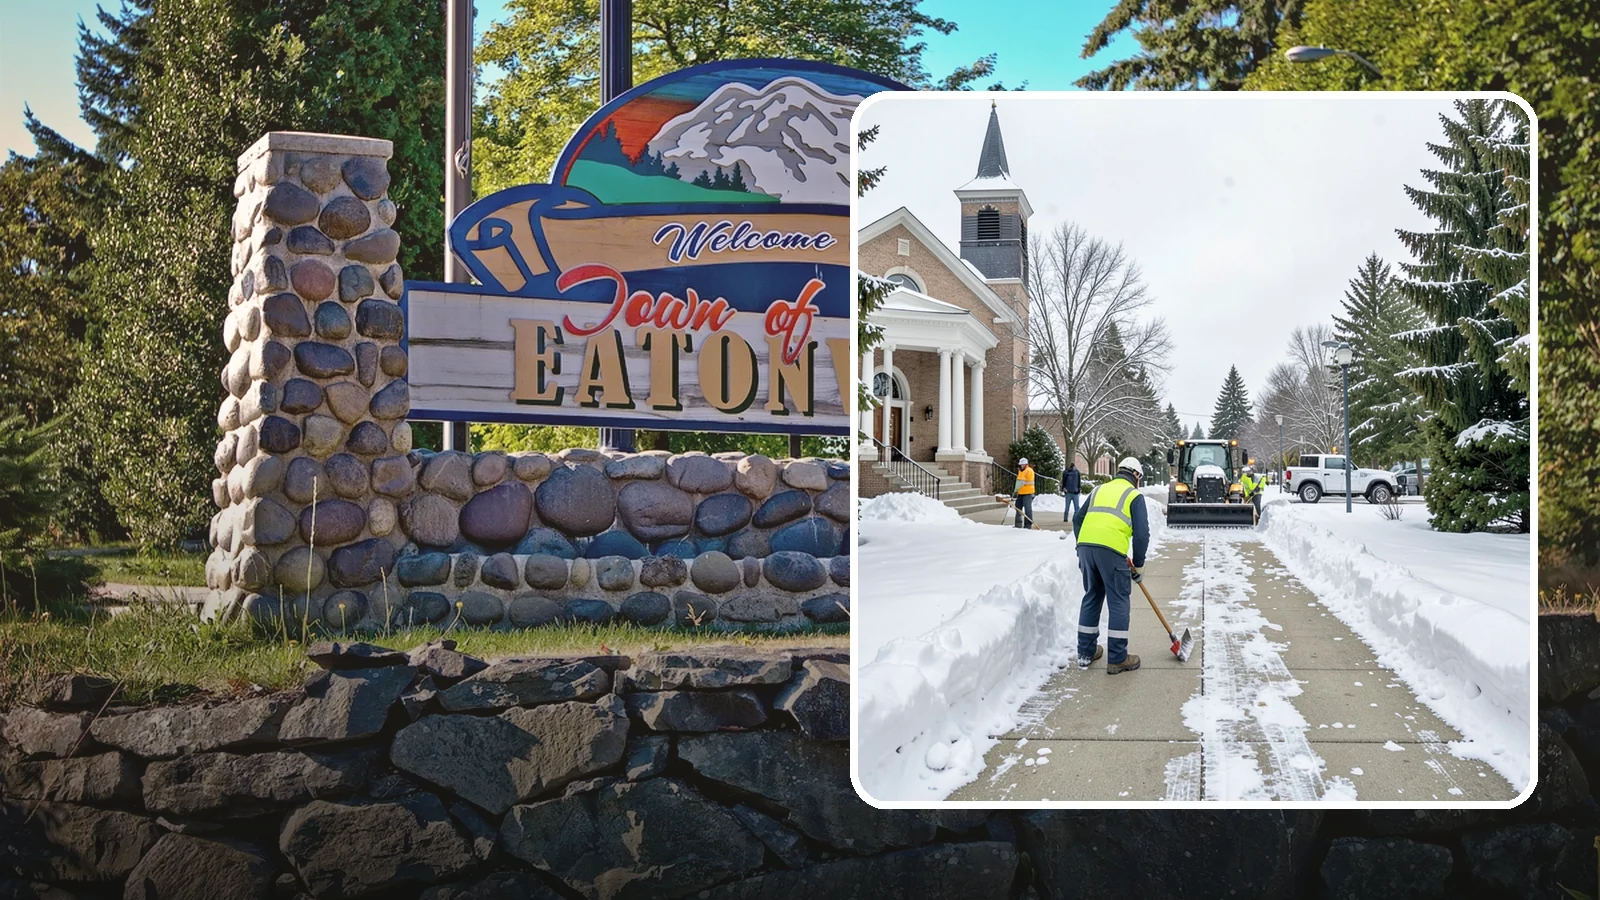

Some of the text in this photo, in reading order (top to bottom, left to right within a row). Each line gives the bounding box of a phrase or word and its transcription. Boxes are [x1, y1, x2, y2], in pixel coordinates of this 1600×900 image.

[653, 220, 837, 264] Welcome
[556, 263, 826, 365] Town of
